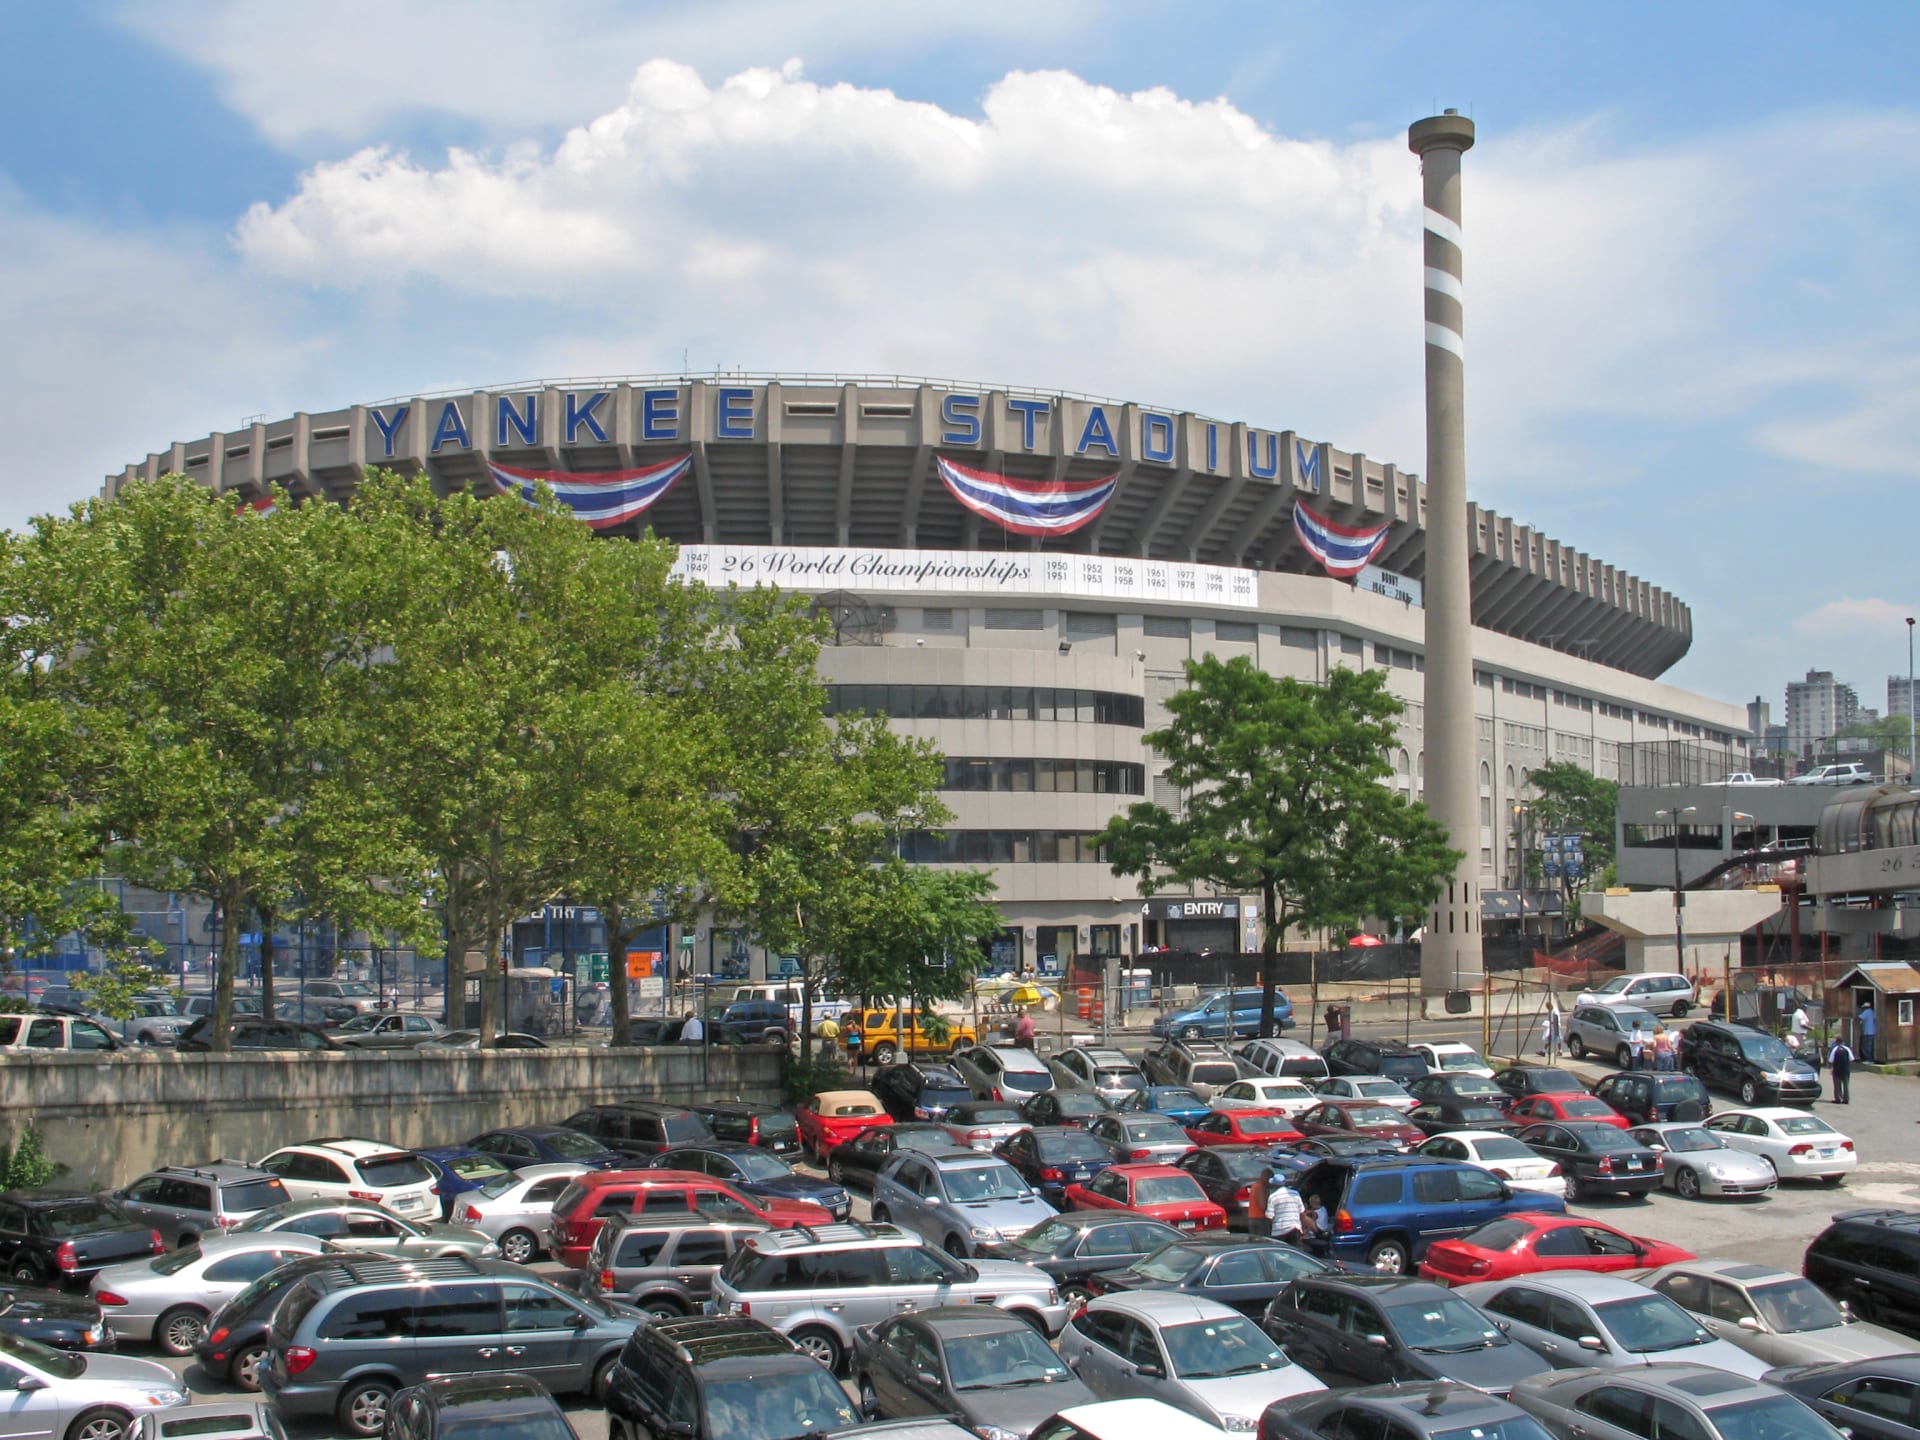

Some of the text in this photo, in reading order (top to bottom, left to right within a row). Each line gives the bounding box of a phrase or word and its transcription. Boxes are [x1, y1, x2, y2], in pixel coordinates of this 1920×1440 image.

[370, 387, 1321, 491] YANKEE STADIUM
[685, 553, 708, 562] 1947
[685, 563, 708, 572] 1949
[720, 552, 1031, 584] 26 World Championships
[1046, 561, 1250, 585] 1950 1952 1956 1961 1977 1996 1999
[1046, 571, 1250, 594] 1951 1953 1958 1962 1978 1998 2000
[1141, 903, 1150, 915] 4
[1183, 902, 1224, 915] ENTRY
